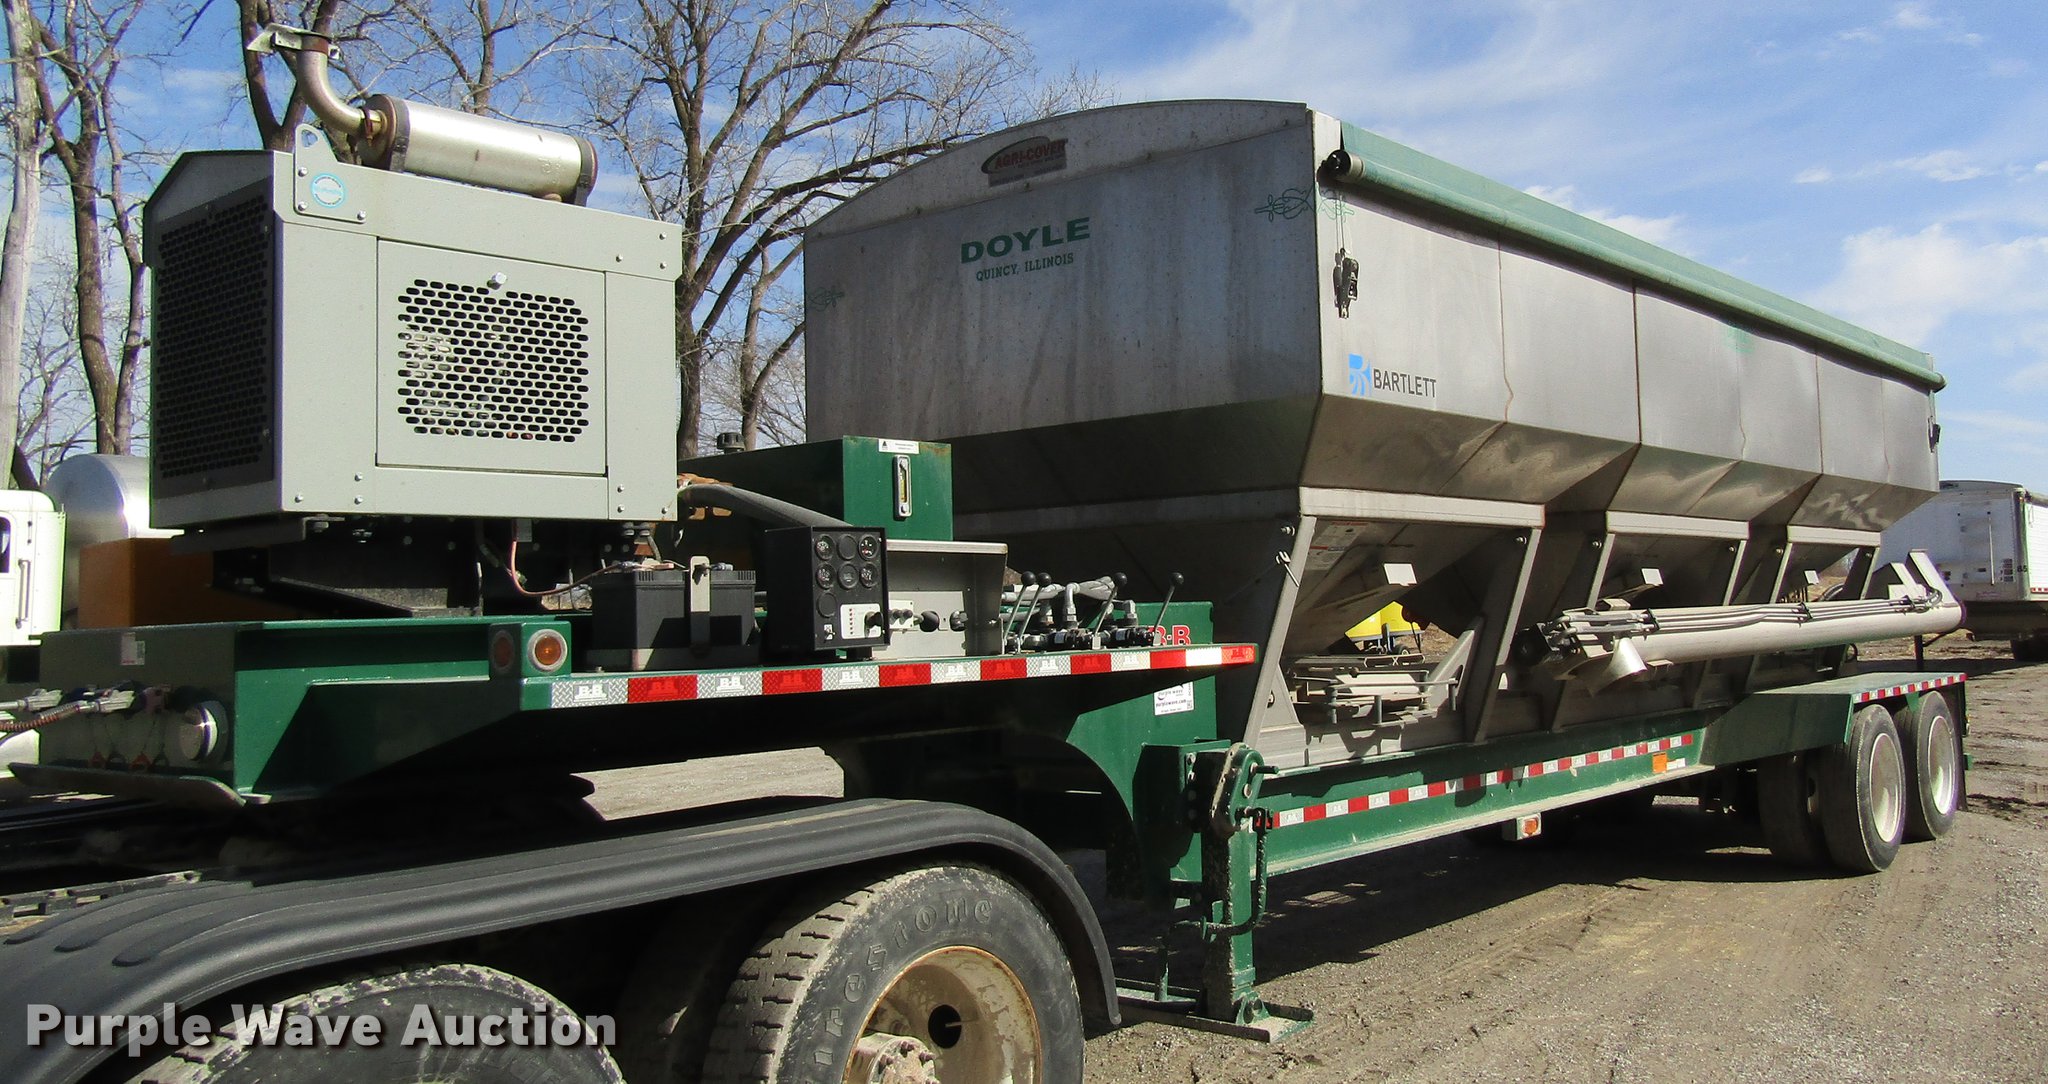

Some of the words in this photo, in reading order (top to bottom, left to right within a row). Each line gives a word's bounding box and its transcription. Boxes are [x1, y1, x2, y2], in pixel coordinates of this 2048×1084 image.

[961, 217, 1090, 264] DOYLE
[976, 264, 1019, 281] QUINCY,
[1024, 253, 1074, 272] ILLINOIS
[1373, 368, 1436, 398] BARTLETT
